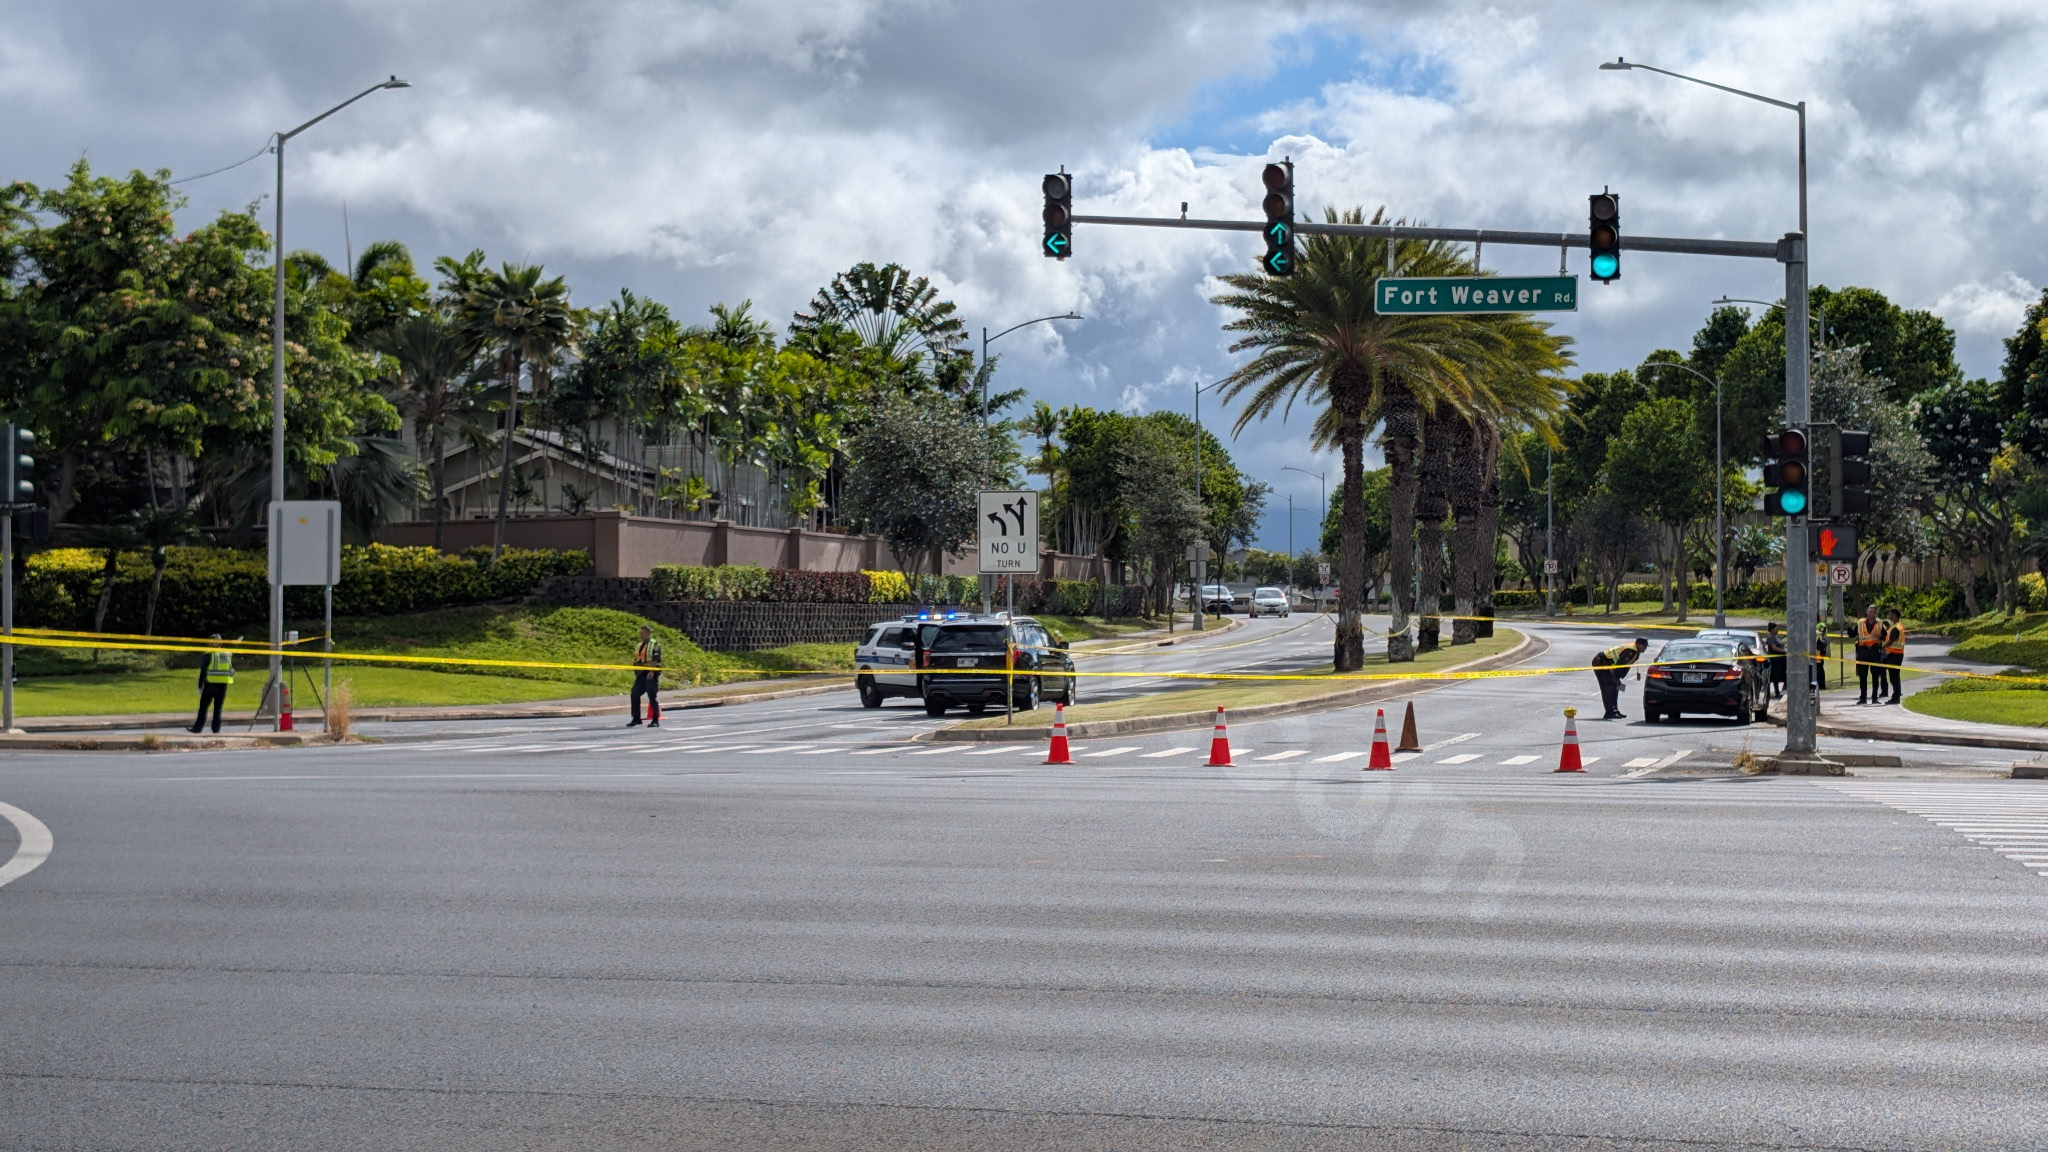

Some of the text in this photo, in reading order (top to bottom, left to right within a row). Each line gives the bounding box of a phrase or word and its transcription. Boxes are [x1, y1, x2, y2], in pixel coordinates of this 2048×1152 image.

[1384, 286, 1438, 305] Fort
[1451, 286, 1542, 305] Weaver
[991, 542, 1026, 554] NO U
[996, 559, 1021, 568] TURN
